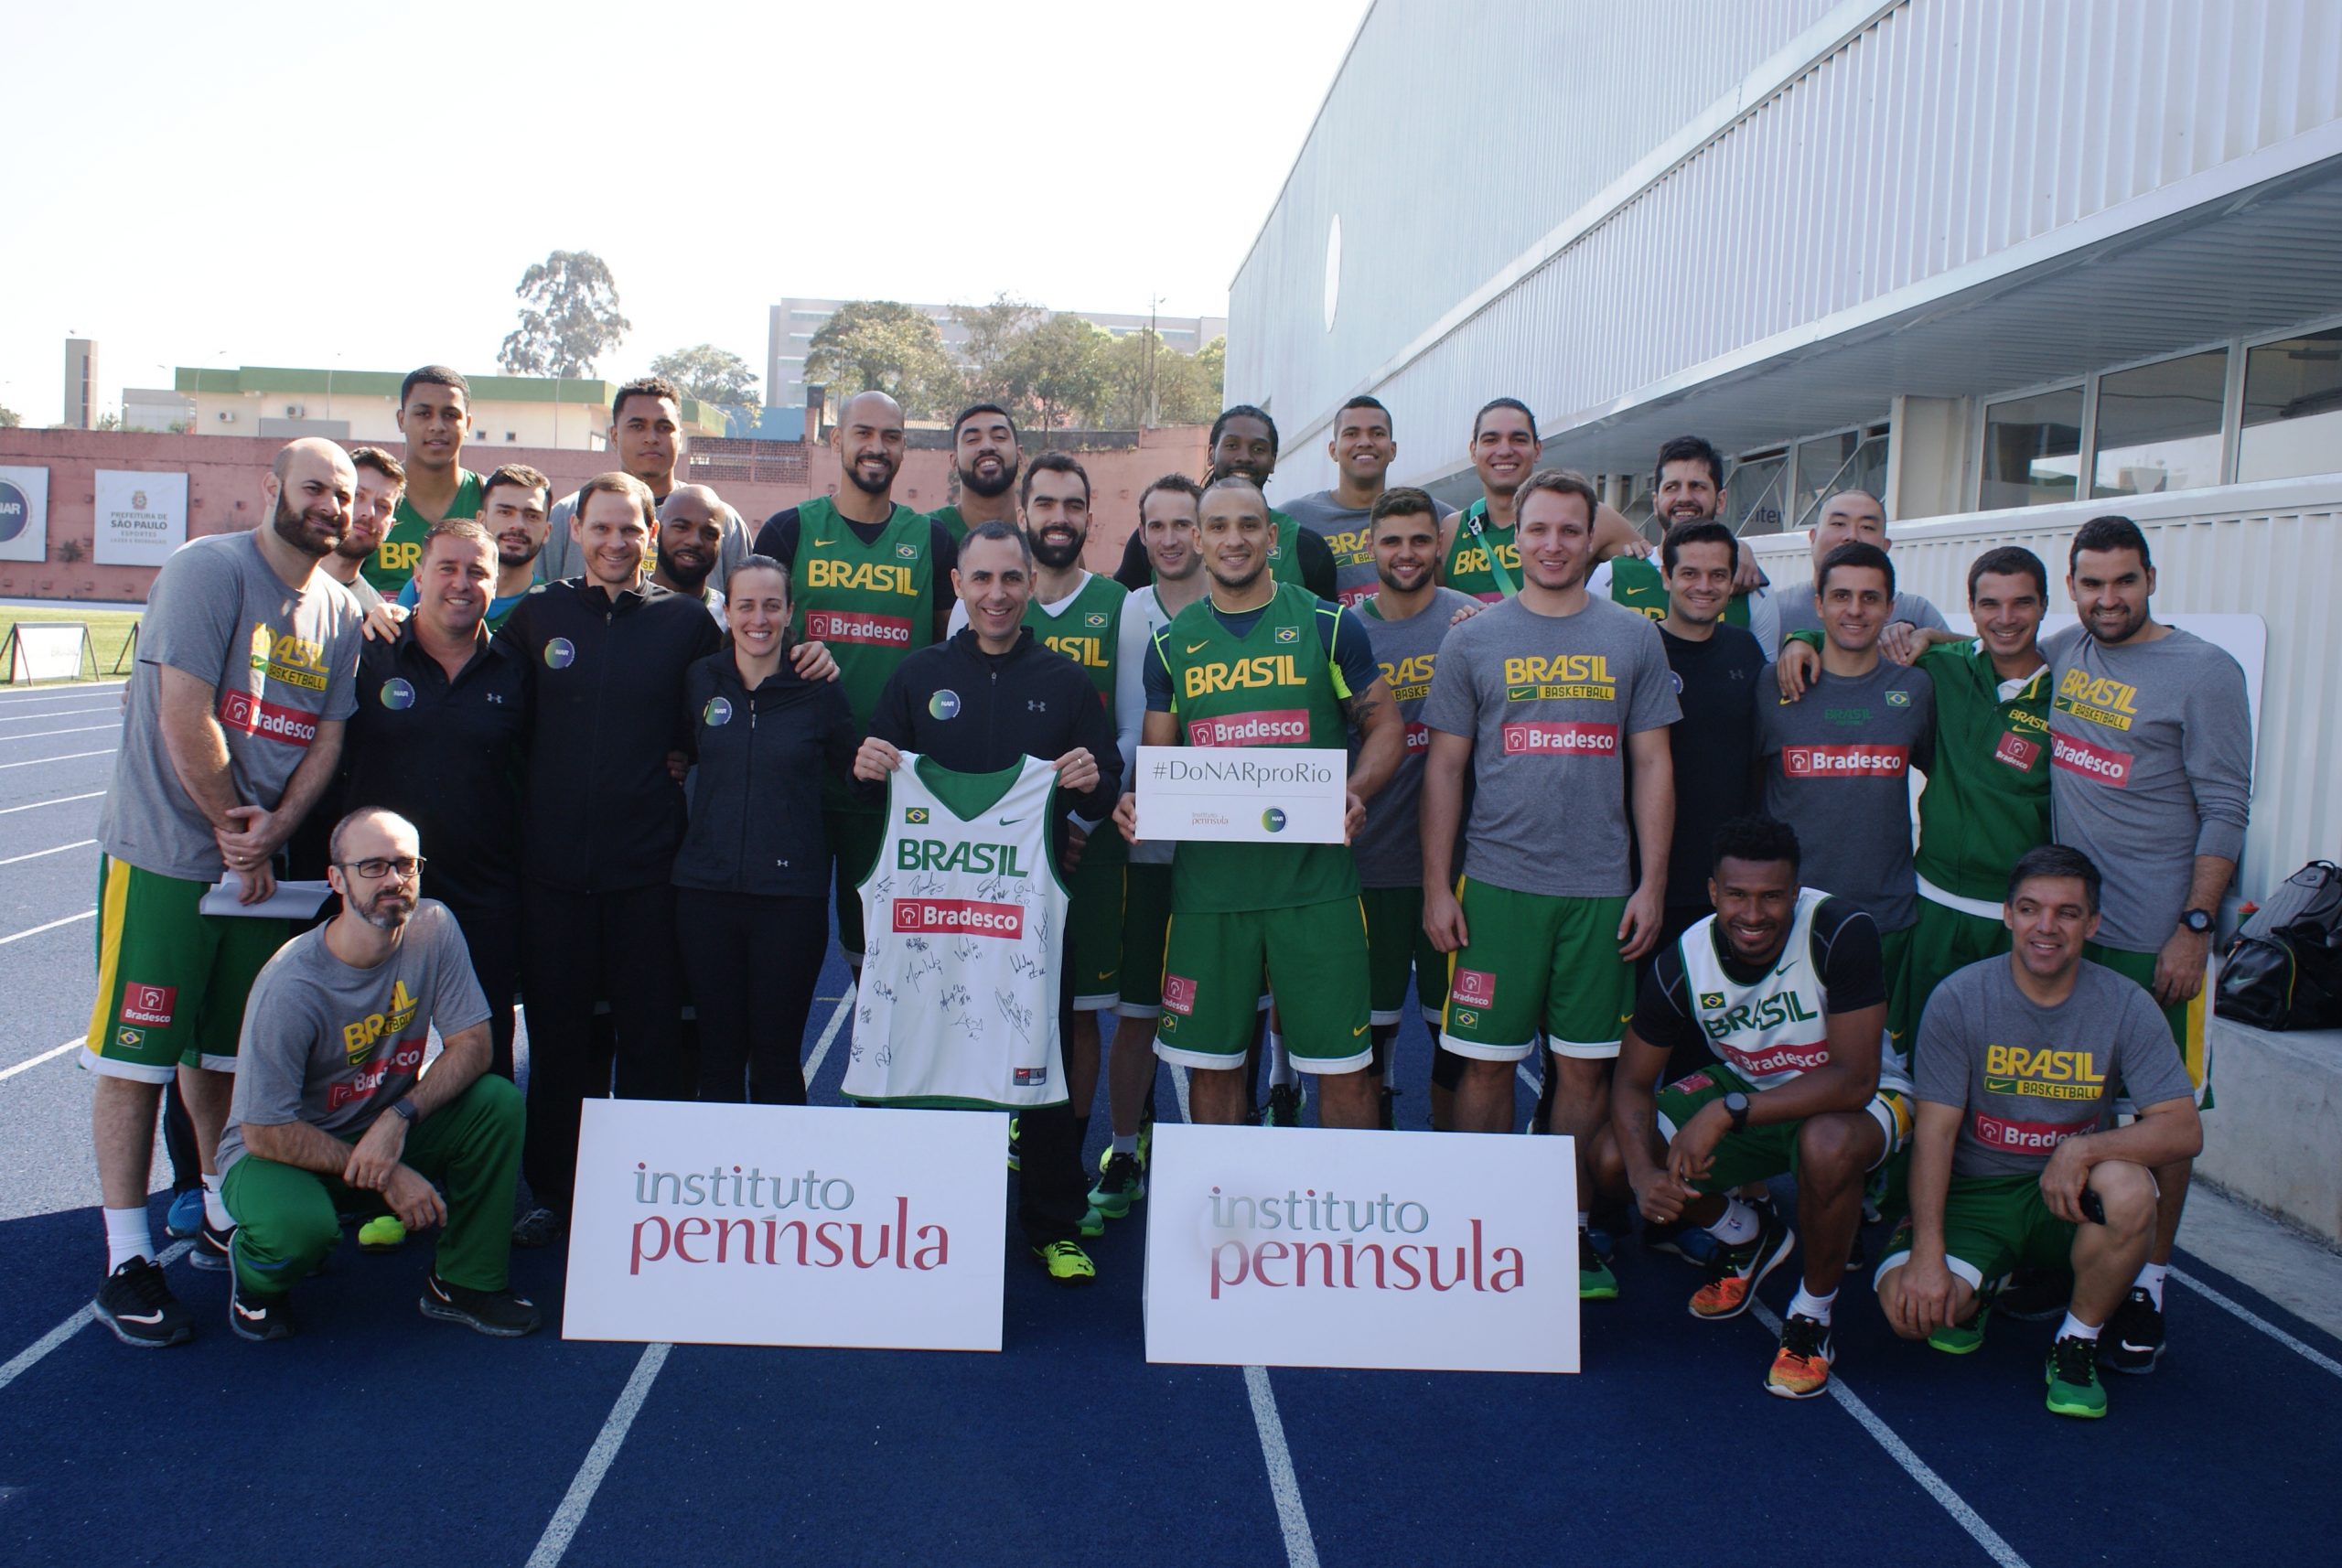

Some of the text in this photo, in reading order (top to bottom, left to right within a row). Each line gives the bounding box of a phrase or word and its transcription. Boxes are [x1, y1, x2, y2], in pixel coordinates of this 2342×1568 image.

[134, 521, 167, 530] PAULO
[1323, 529, 1370, 554] BRA
[808, 559, 919, 596] BRASIL
[831, 618, 908, 641] Bradesco
[252, 622, 329, 673] BRASIL
[1045, 636, 1110, 667] ASIL
[268, 665, 323, 689] BASKETBALL
[1186, 655, 1307, 698] BRASIL
[1377, 654, 1435, 686] RAS
[1505, 655, 1616, 684] BRASIL
[1395, 685, 1428, 700] BASKE
[1544, 685, 1611, 699] BASKETBALL
[2059, 668, 2138, 714] BRASIL
[252, 705, 316, 740] Bradesco
[2074, 703, 2124, 728] BASKETBALL
[1214, 719, 1304, 742] Bradesco
[1529, 729, 1614, 750] Bradesco
[1812, 752, 1901, 769] Bradesco
[1995, 750, 2028, 769] Bradesco
[2054, 739, 2123, 778] Bradesco
[1153, 760, 1331, 788] #DoNARproRio
[897, 839, 1028, 877] BRASIL
[924, 906, 1018, 930] Bradesco
[1453, 990, 1489, 1005] Bradesco
[124, 1008, 171, 1023] Bradesco
[1702, 991, 1818, 1039] BRASIL
[1741, 1050, 1830, 1072] Bradesco
[1986, 1044, 2106, 1081] BRASIL
[2022, 1082, 2099, 1099] BASKETBALL
[633, 1162, 855, 1210] instituto
[1208, 1186, 1430, 1234] instituto
[629, 1196, 949, 1276] península
[1210, 1219, 1525, 1300] península
